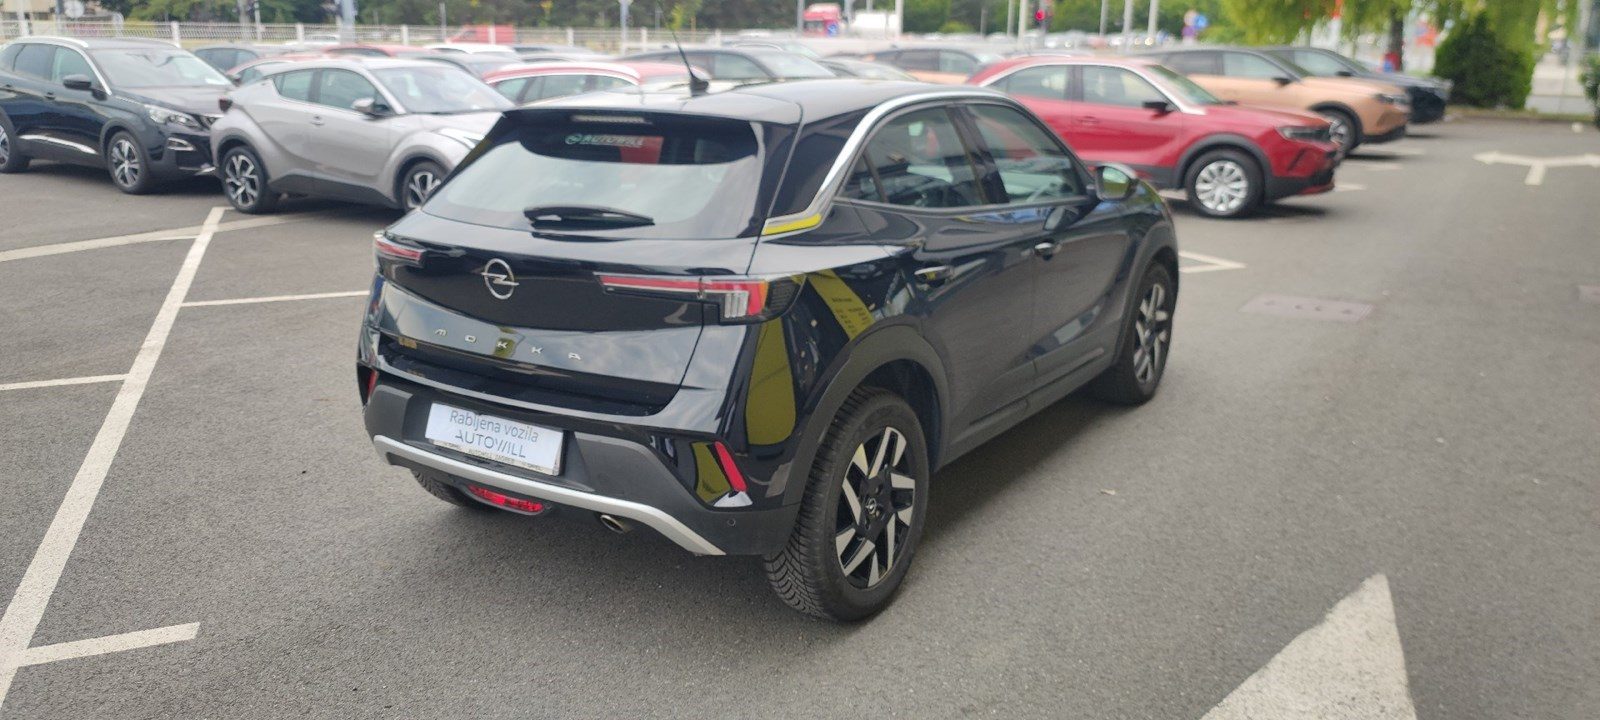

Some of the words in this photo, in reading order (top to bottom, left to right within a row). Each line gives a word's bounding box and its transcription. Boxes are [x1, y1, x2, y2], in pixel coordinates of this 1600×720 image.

[434, 327, 582, 361] MOKKA
[449, 410, 501, 432] Rabljena
[503, 424, 539, 443] vozila
